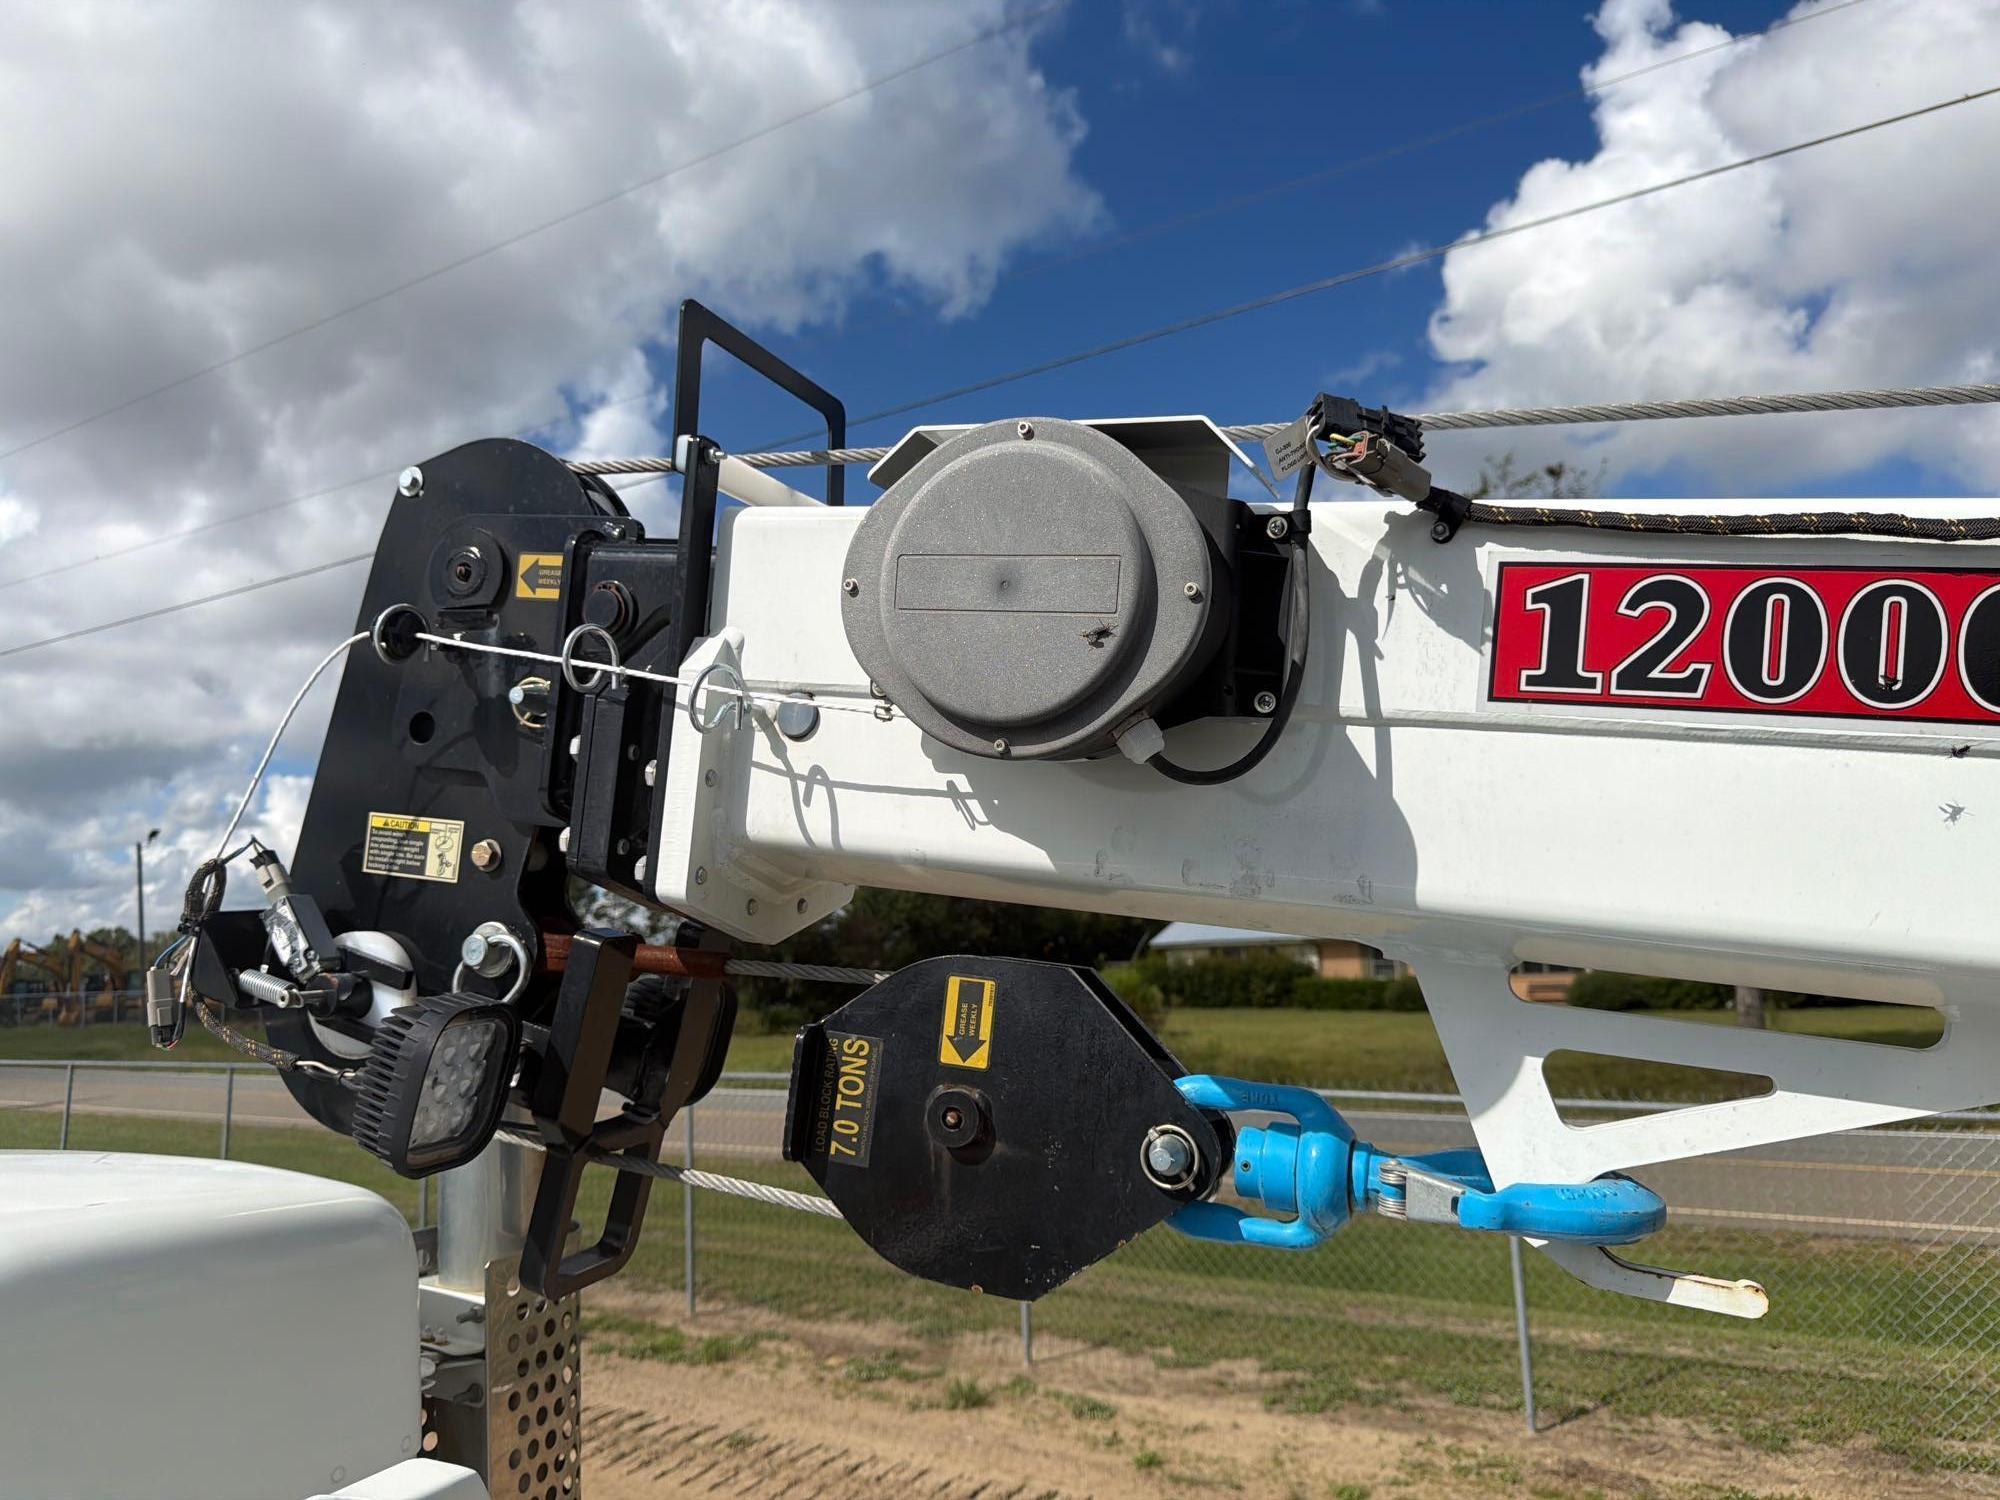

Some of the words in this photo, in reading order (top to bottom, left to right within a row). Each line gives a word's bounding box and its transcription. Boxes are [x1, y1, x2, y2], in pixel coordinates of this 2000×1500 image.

[390, 820, 420, 830] CAUTION
[959, 1003, 968, 1035] GREASE
[968, 1003, 978, 1037] WEEKLY
[823, 1038, 839, 1079] RATING
[835, 1039, 870, 1110] TONS
[819, 1081, 833, 1120] BLOCK
[815, 1121, 827, 1153] LOAD
[831, 1120, 860, 1156] 7.0
